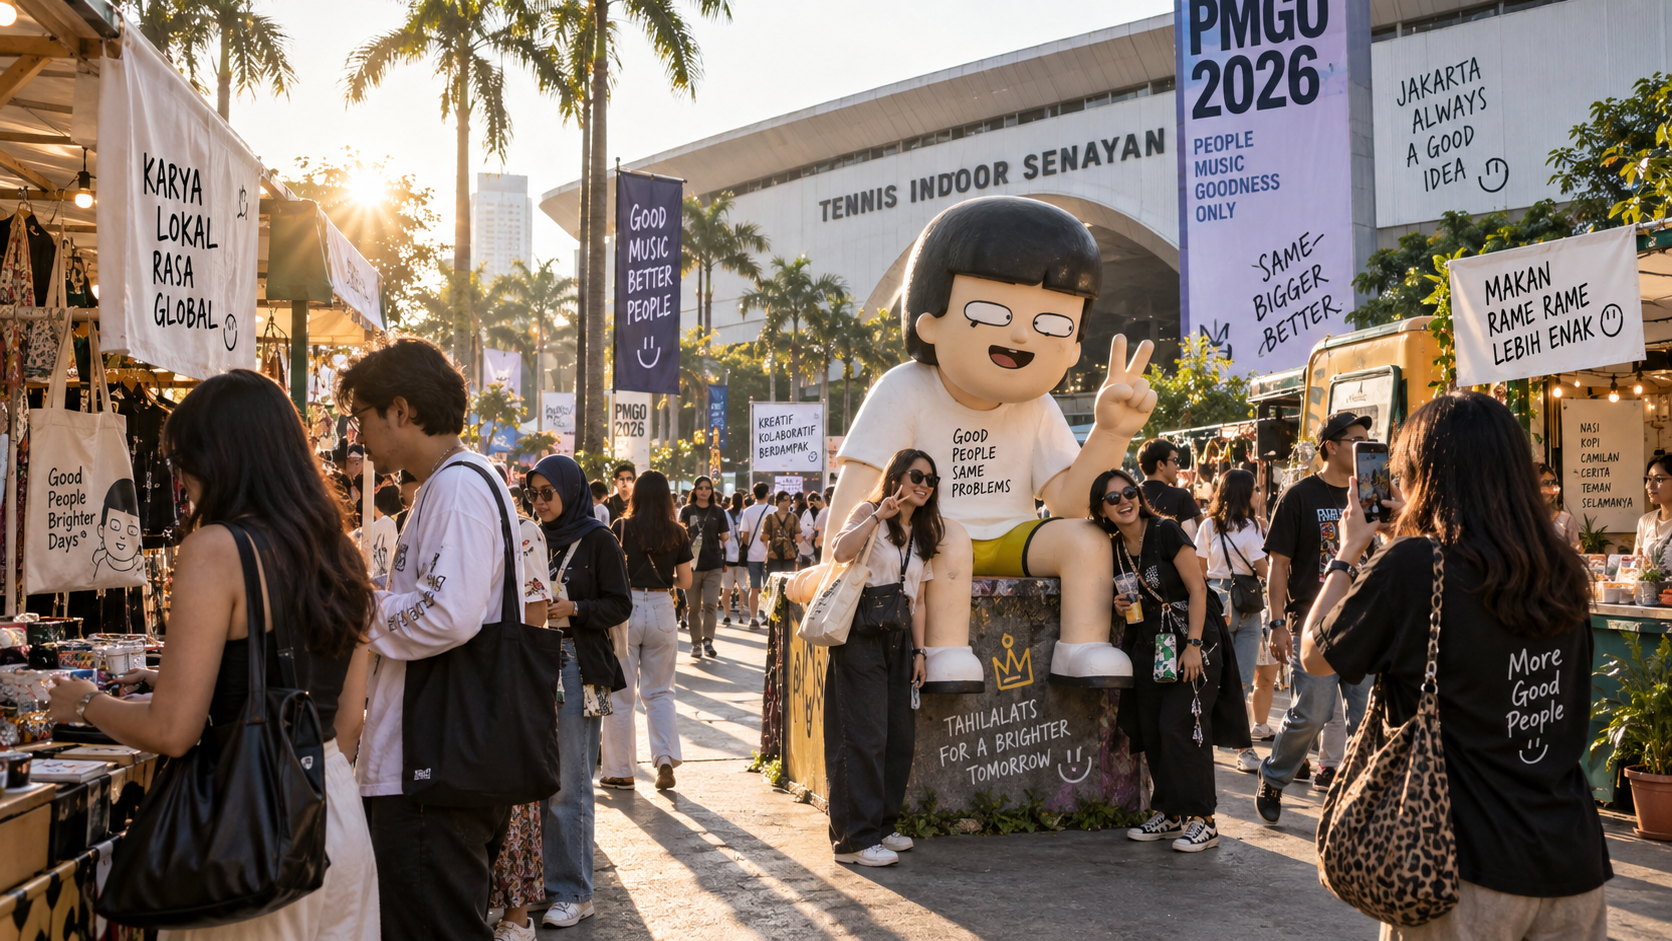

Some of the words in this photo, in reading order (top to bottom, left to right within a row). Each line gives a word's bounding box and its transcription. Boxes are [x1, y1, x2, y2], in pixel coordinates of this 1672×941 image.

[1190, 0, 1328, 55] PMGO
[1192, 44, 1319, 119] 2026
[1397, 57, 1481, 107] JAKARTA
[1412, 87, 1486, 134] ALWAYS
[1194, 131, 1254, 155] PEOPLE
[1407, 143, 1419, 167] A
[1427, 125, 1474, 158] GOOD
[144, 152, 202, 206] KARYA
[819, 185, 897, 222] TENNIS
[911, 161, 1008, 203] INDOOR
[1023, 128, 1164, 180] SENAYAN
[1195, 155, 1244, 177] MUSIC
[1424, 158, 1466, 192] IDEA
[1195, 173, 1280, 200] GOODNESS
[630, 204, 666, 231] GOOD
[1196, 202, 1236, 222] ONLY
[157, 206, 218, 249] LOKAL
[629, 236, 668, 263] MUSIC
[153, 250, 193, 288] RASA
[628, 265, 673, 294] BETTER
[1252, 264, 1329, 322] BIGGER
[1486, 261, 1551, 306] MAKAN
[154, 292, 218, 329] GLOBAL
[628, 294, 671, 325] PEOPLE
[1488, 301, 1535, 337] RAME
[1543, 283, 1590, 316] RAME
[1494, 330, 1541, 365] LEBIH
[1549, 316, 1594, 347] ENAK
[615, 403, 646, 420] PMGO
[759, 414, 793, 429] KREATIF
[615, 421, 644, 437] 2026
[759, 425, 816, 444] KOLABORATIF
[953, 428, 988, 446] GOOD
[1580, 423, 1599, 433] NASI
[759, 442, 808, 459] BERDAMPAK
[953, 446, 996, 462] PEOPLE
[1581, 438, 1599, 448] KOPI
[953, 464, 984, 478] SAME
[1581, 452, 1619, 463] CAMILAN
[48, 466, 82, 486] Good
[1581, 467, 1610, 478] CERITA
[49, 489, 86, 510] People
[952, 479, 1010, 498] PROBLEMS
[1582, 483, 1611, 493] TEMAN
[1582, 497, 1633, 508] SELAMANYA
[48, 512, 96, 532] Brighter
[49, 533, 78, 553] Days
[1508, 648, 1562, 680] More
[1512, 670, 1560, 707] Good
[944, 699, 1038, 737] TAHILALATS
[1506, 701, 1563, 738] People
[940, 744, 970, 767] FOR
[978, 738, 987, 757] A
[996, 719, 1071, 752] BRIGHTER
[966, 749, 1052, 785] TOMORROW
